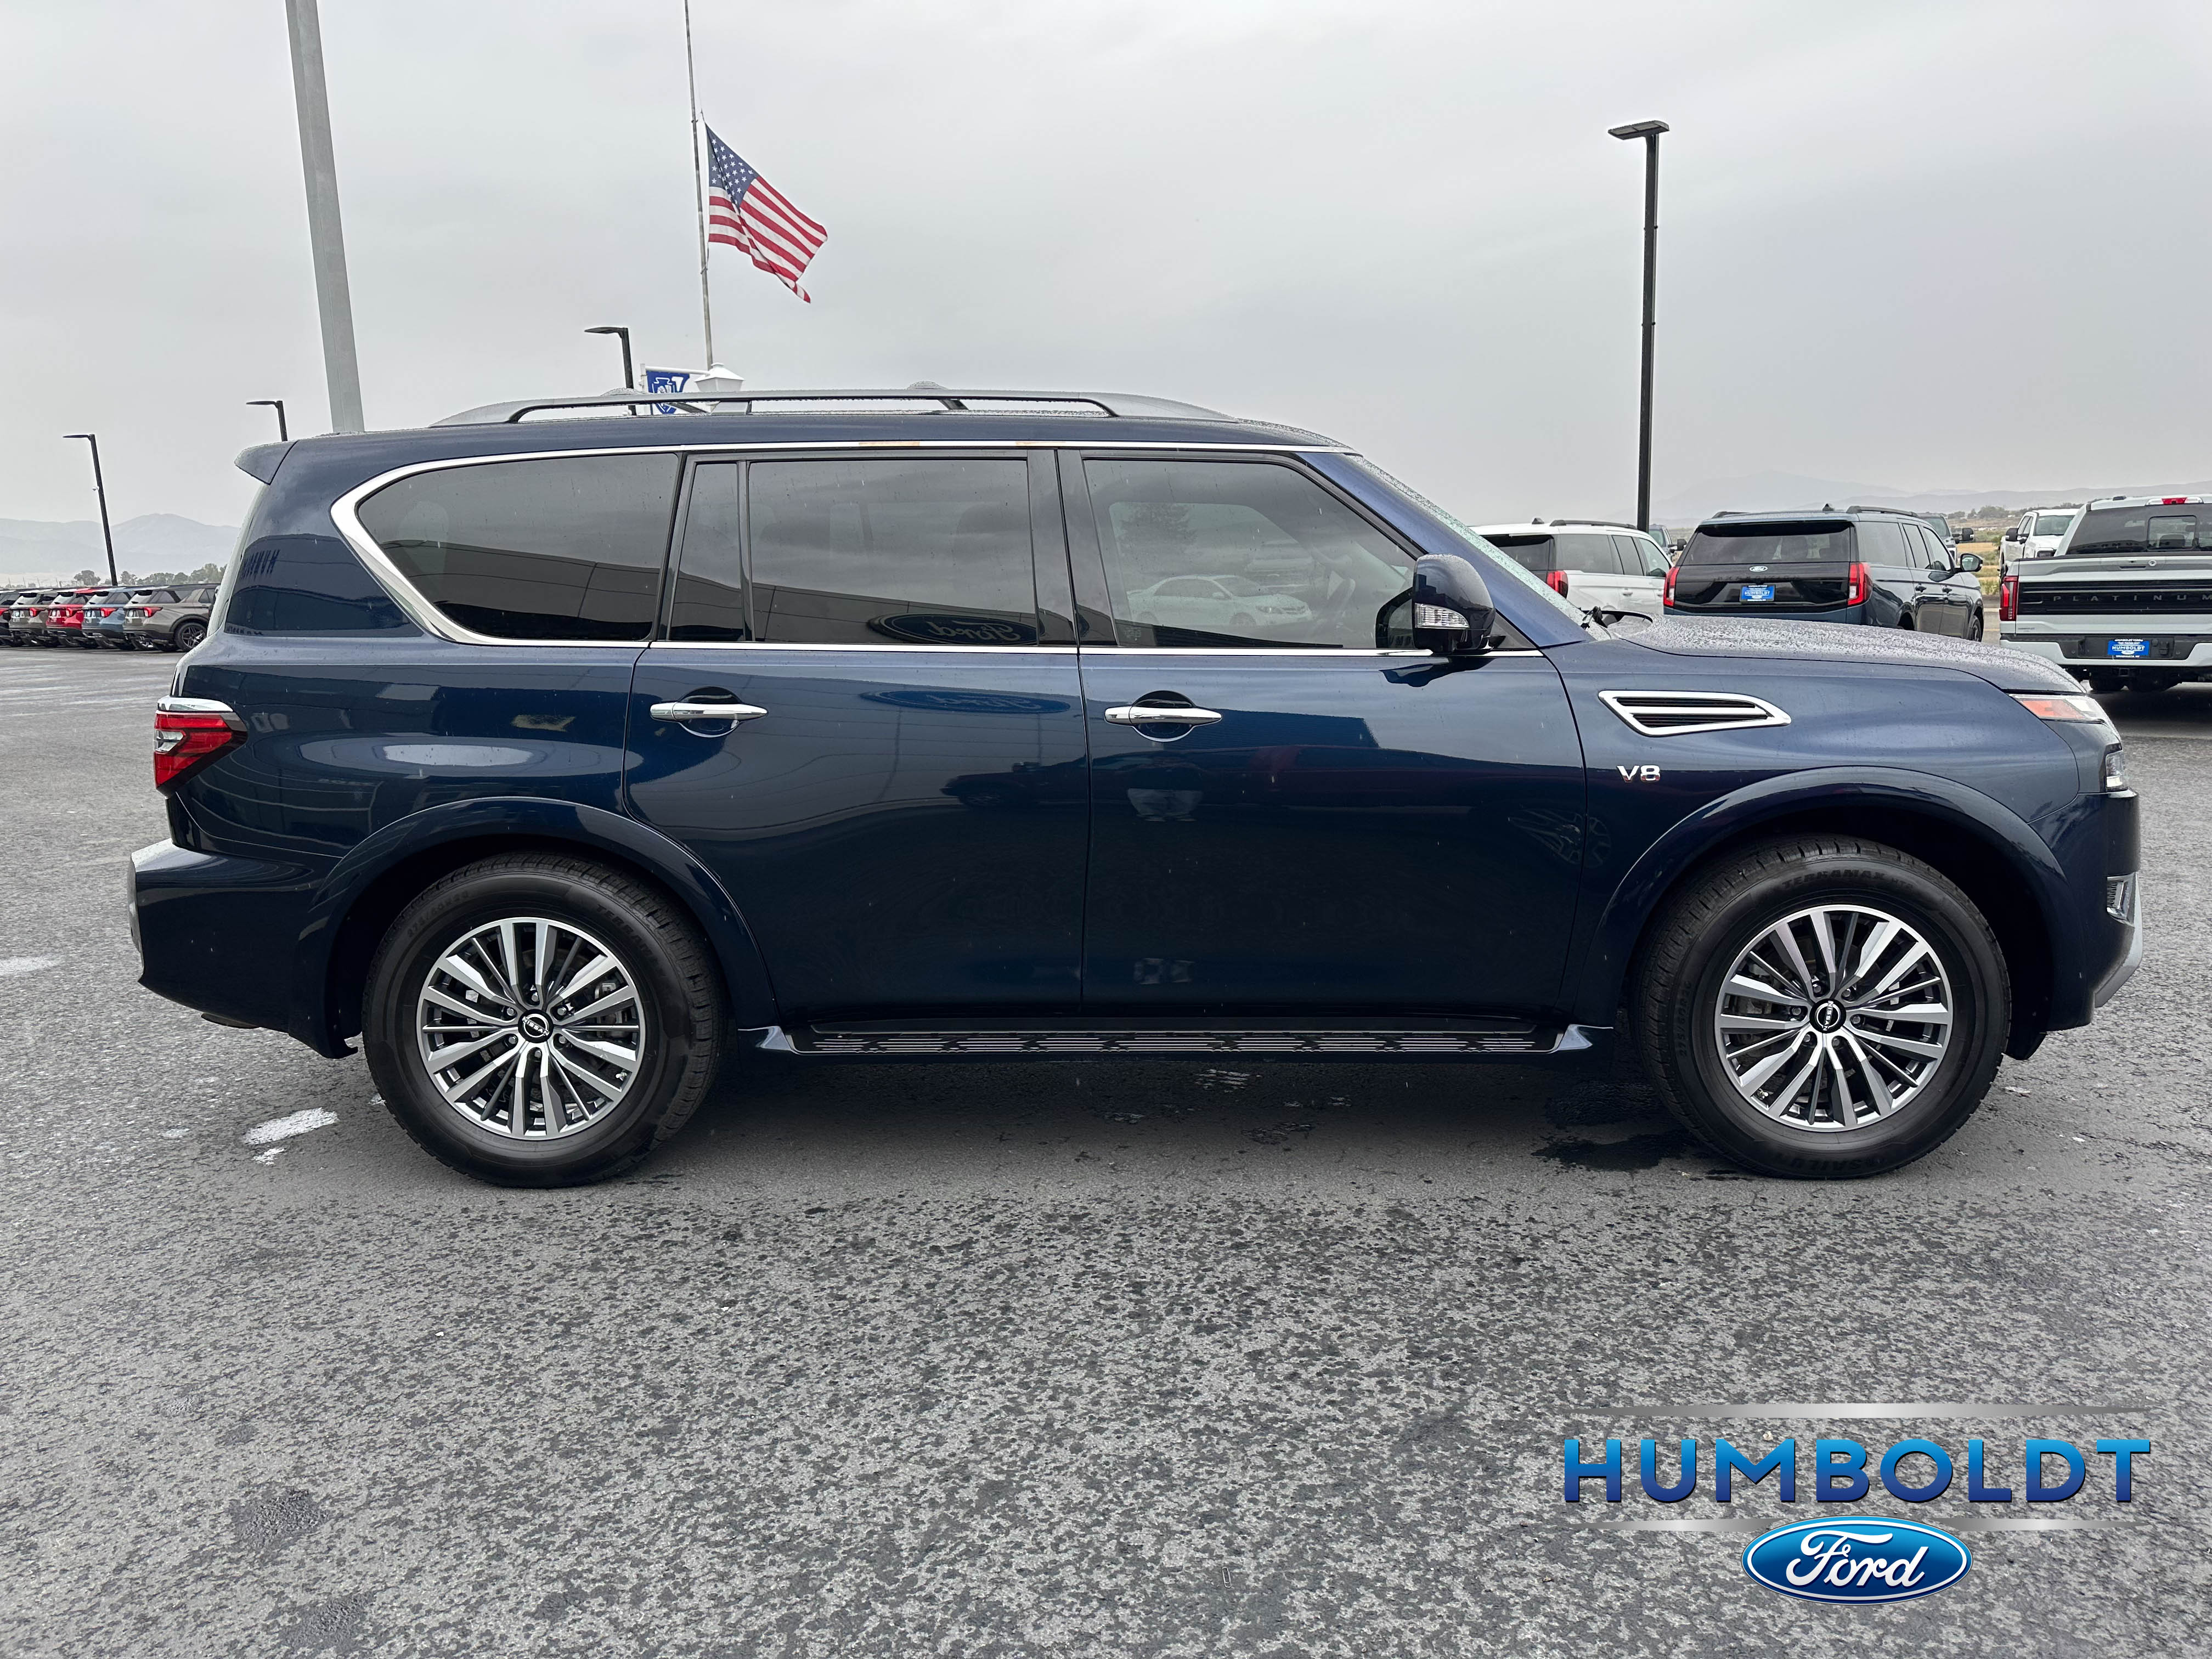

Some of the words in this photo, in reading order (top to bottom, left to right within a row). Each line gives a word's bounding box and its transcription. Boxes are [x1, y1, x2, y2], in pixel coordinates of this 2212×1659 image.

[1616, 765, 1660, 783] V8
[1822, 1000, 1834, 1031] NISSAN
[522, 1016, 550, 1036] NISSAN
